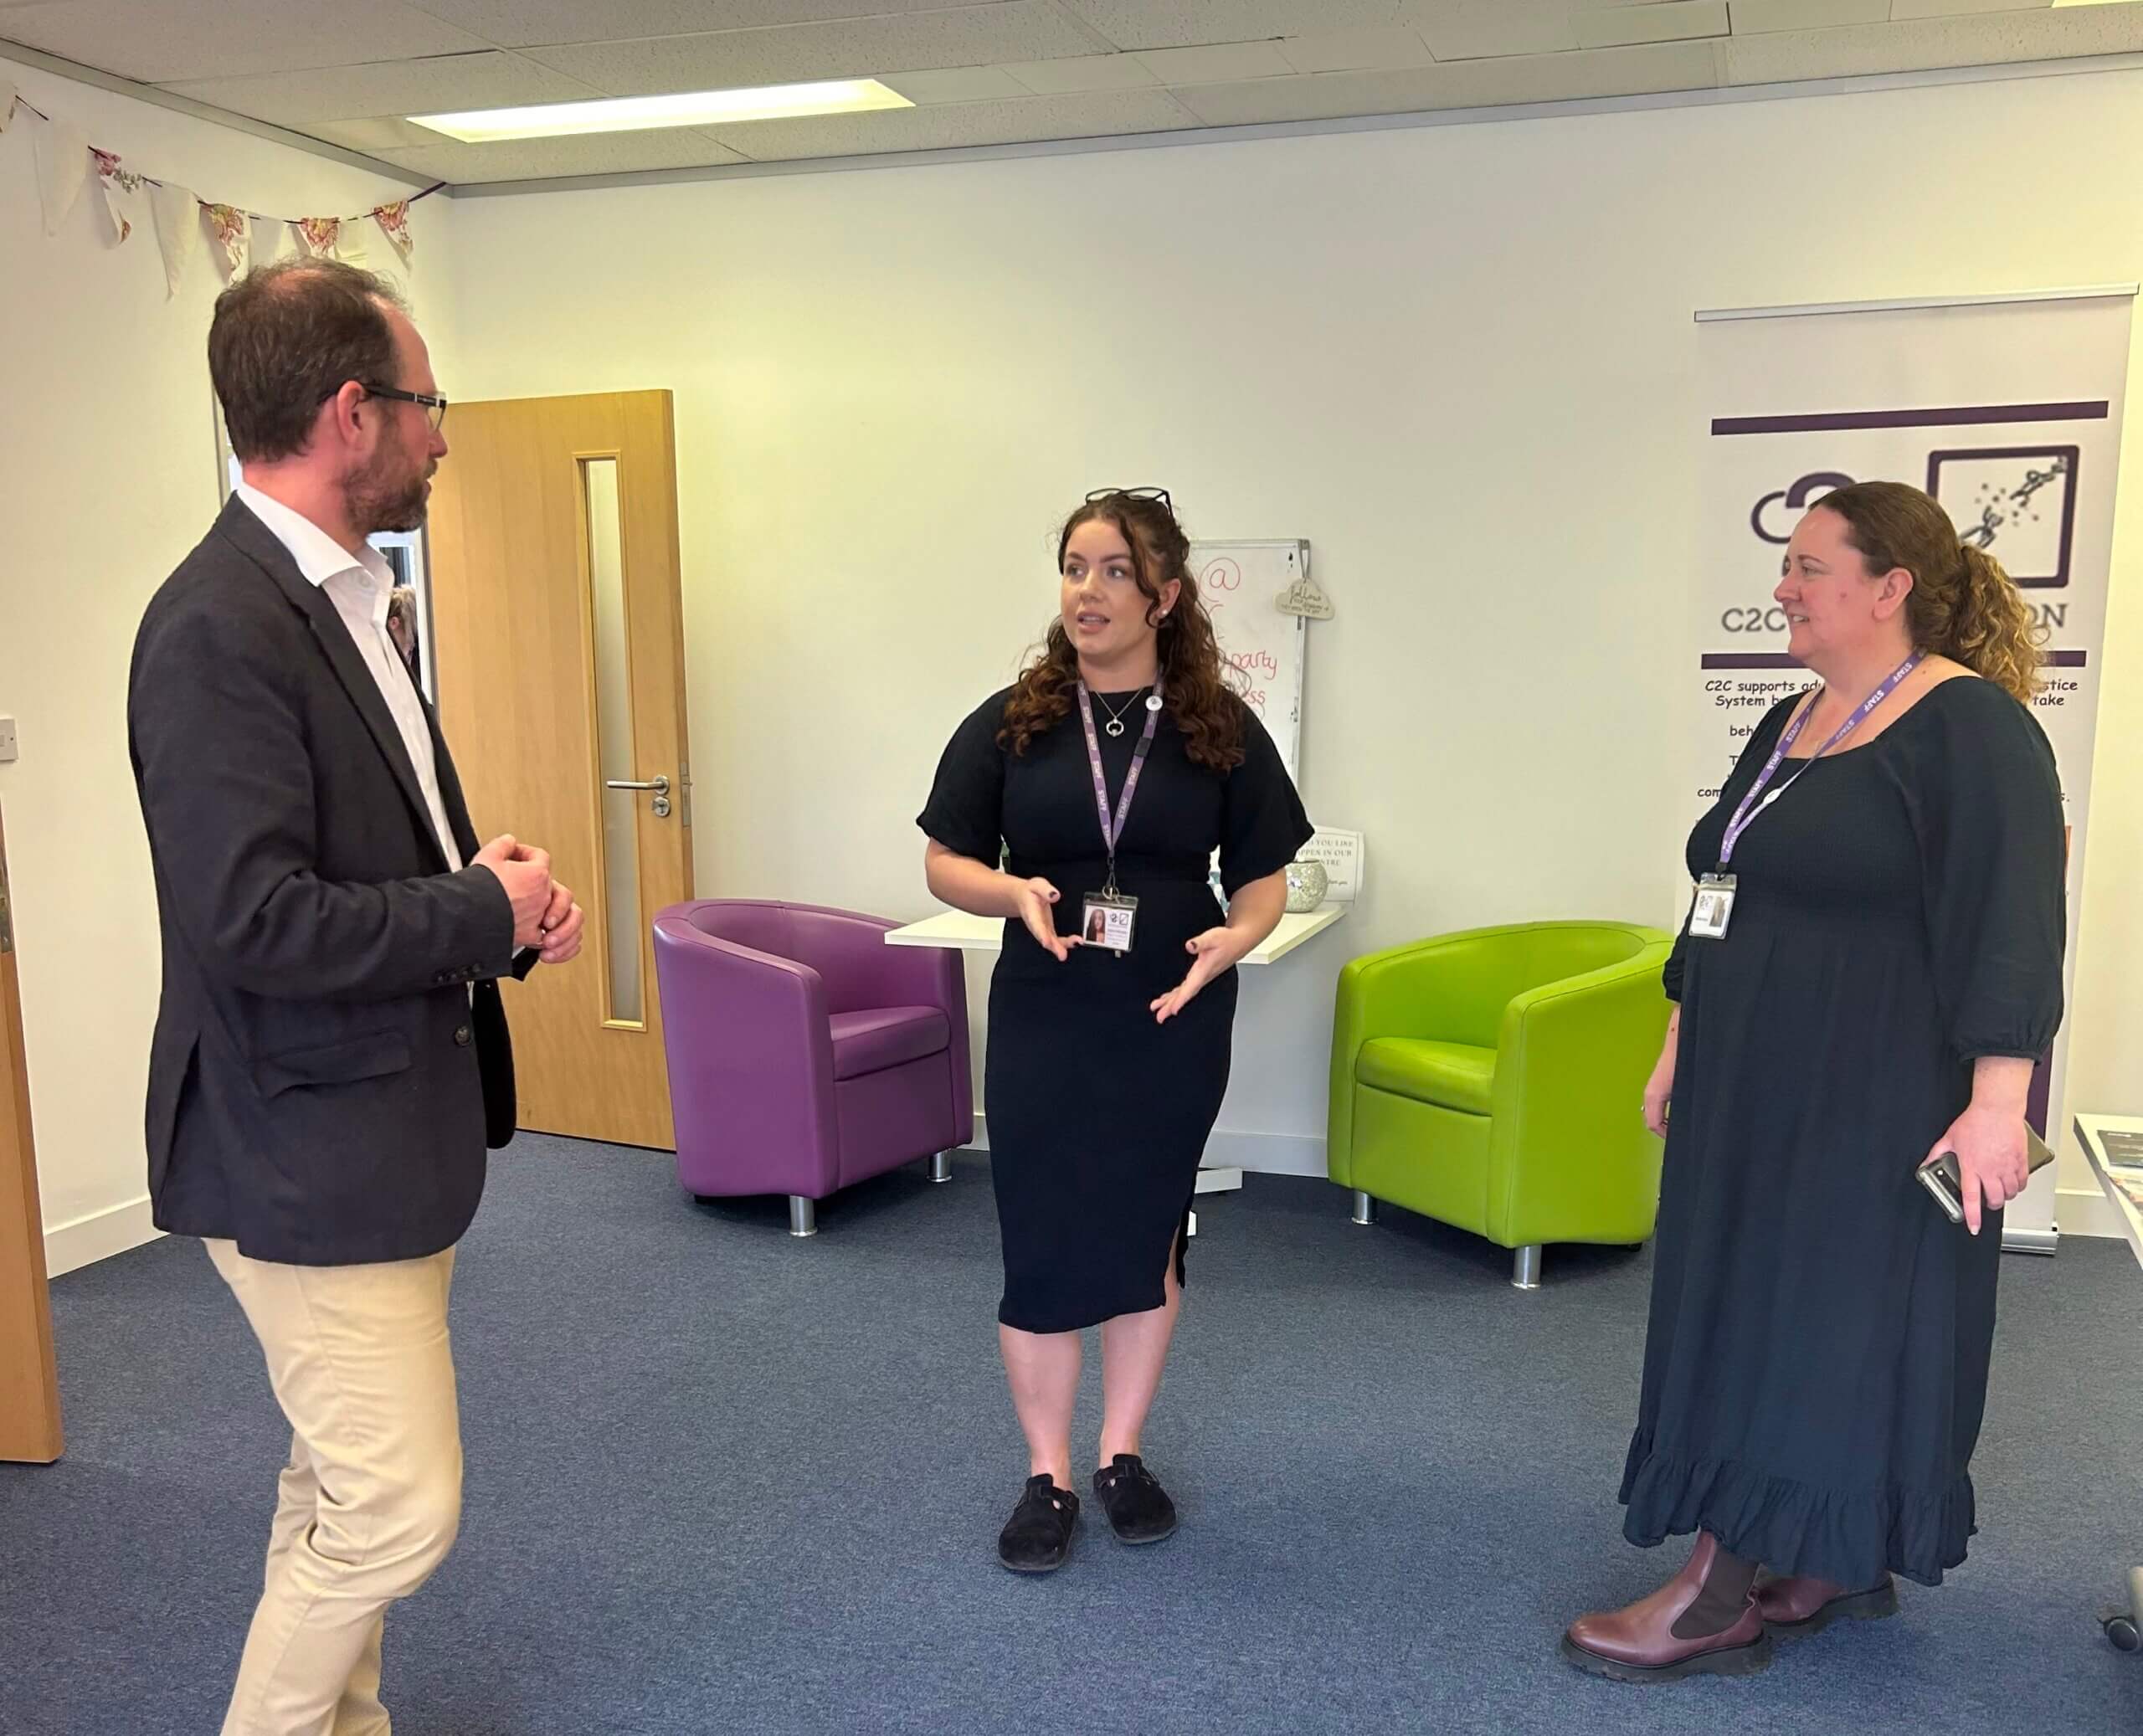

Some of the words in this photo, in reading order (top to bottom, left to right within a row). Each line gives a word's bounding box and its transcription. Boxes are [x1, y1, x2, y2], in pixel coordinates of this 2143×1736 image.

[1721, 607, 1787, 633] C2C
[1229, 650, 1277, 681] party
[1704, 680, 1733, 692] C2C
[1737, 681, 1796, 695] supports
[1714, 695, 1766, 710] System
[1863, 690, 1885, 712] STAFF
[2033, 693, 2065, 706] take
[1766, 750, 1782, 771] STAFF
